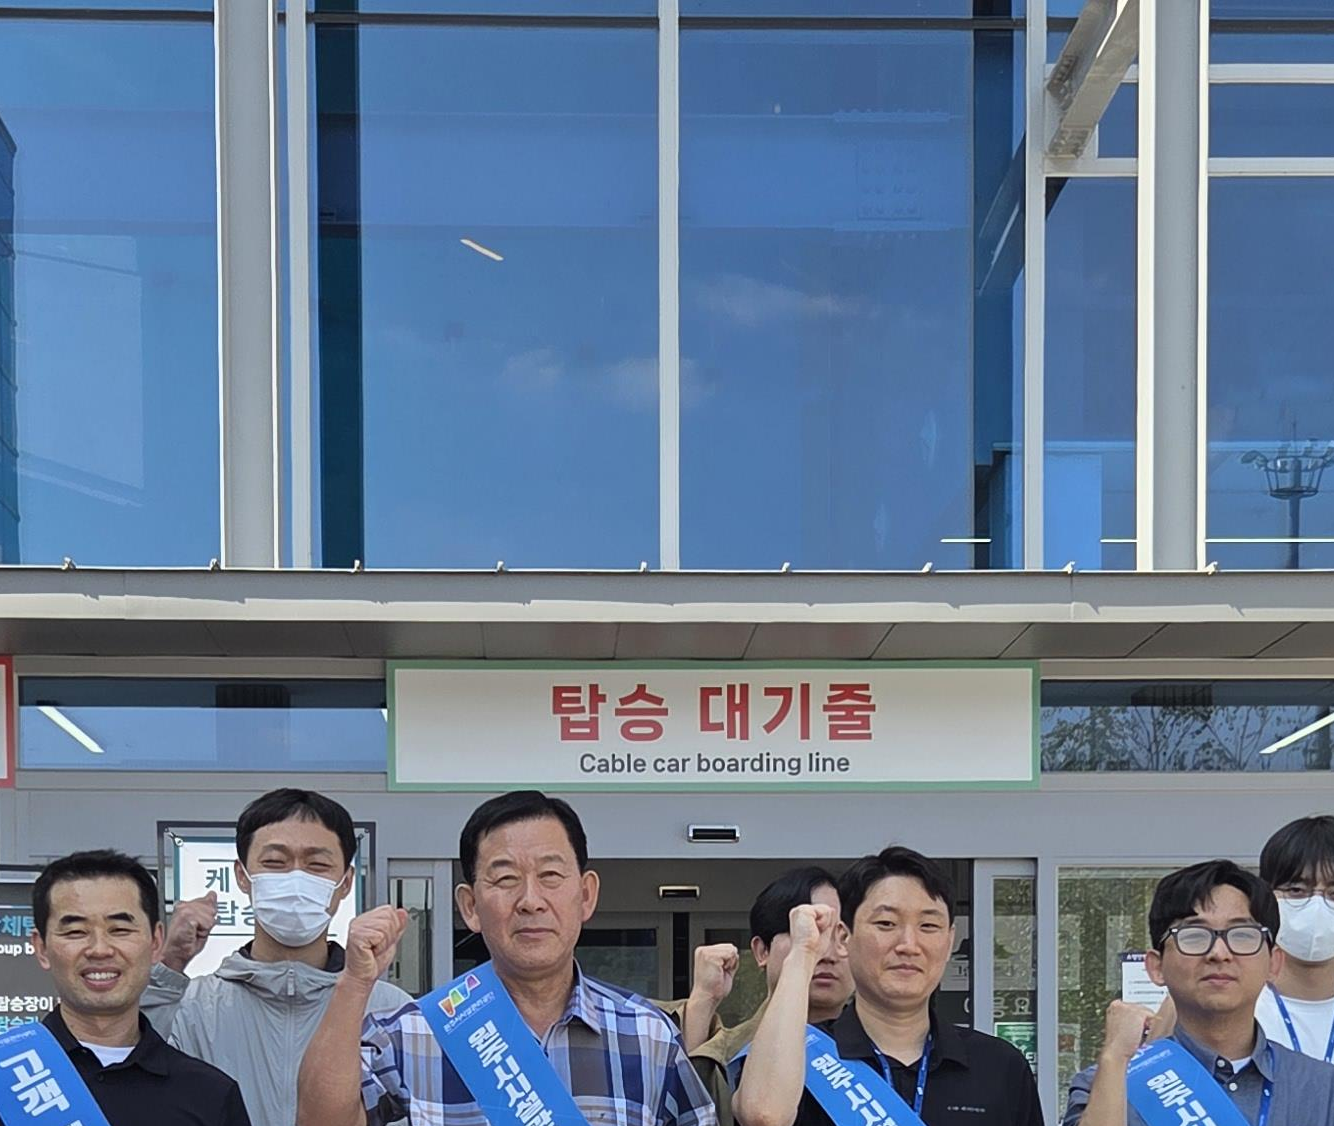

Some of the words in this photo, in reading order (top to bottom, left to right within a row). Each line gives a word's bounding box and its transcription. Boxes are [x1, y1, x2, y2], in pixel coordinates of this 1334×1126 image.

[552, 683, 668, 741] 탑승
[700, 683, 876, 741] 대기줄
[579, 753, 647, 773] Cable
[653, 756, 690, 773] car
[696, 752, 801, 775] boarding
[809, 752, 850, 773] line
